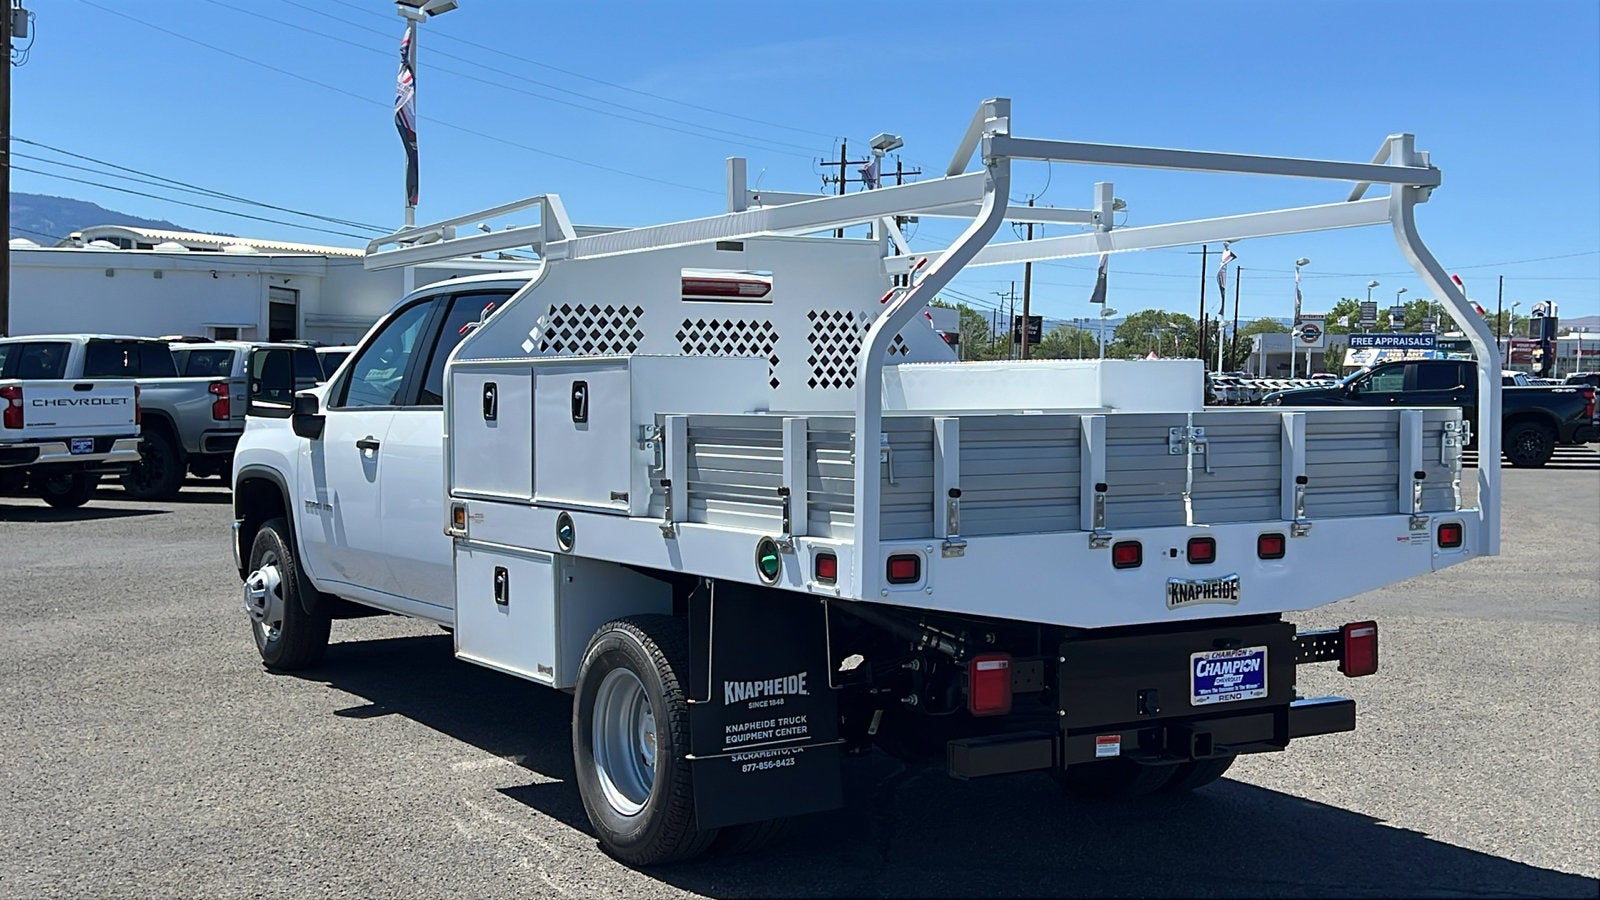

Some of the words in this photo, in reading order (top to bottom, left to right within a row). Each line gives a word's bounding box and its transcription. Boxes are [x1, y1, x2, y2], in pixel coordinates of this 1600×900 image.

[1351, 337, 1373, 345] FREE
[1374, 337, 1434, 346] APPRAISALS!
[32, 398, 128, 406] CHEVROLET
[1171, 579, 1238, 605] KNAPHEIDE
[1212, 649, 1247, 659] CHAMPION
[1196, 658, 1260, 677] CHAMPION
[724, 672, 807, 705] KNAPHEIDE
[748, 700, 768, 709] SINCE
[769, 698, 784, 706] 1848
[1218, 693, 1242, 701] RENO
[725, 719, 775, 733] KNAPHEIDE
[778, 715, 807, 726] TRUCK
[725, 729, 773, 743] EQUIPMENT
[775, 725, 807, 737] CENTER
[742, 757, 795, 772] 877-856-8423
